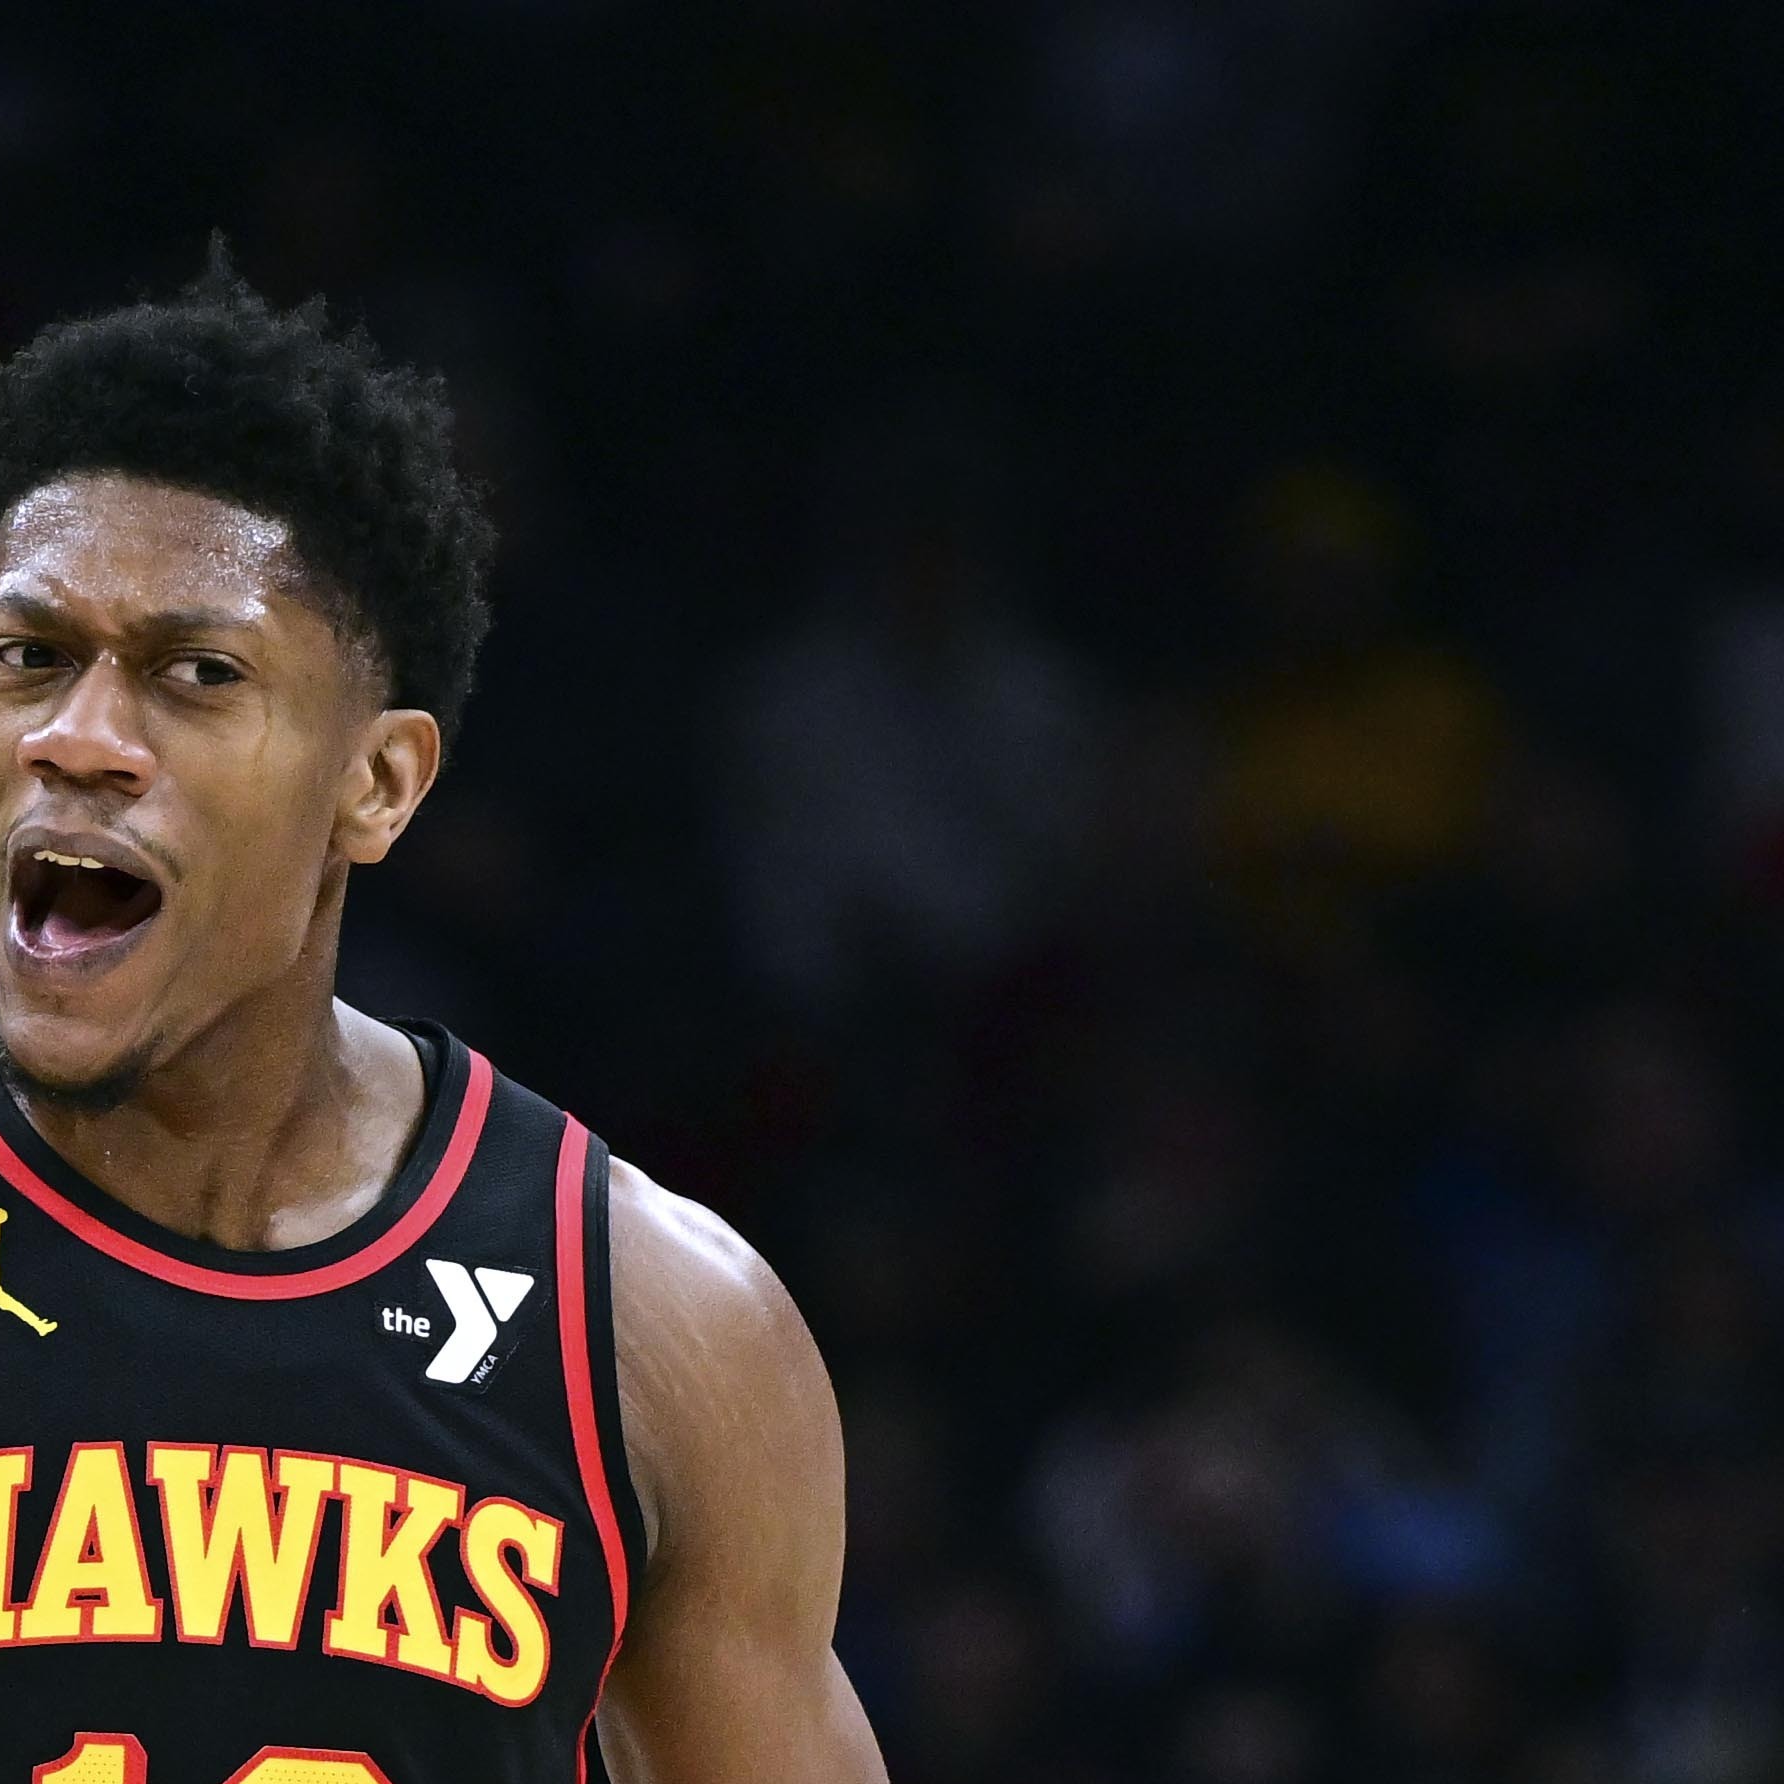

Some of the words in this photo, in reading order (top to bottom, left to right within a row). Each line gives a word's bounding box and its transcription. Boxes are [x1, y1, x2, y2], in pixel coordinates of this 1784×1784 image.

[381, 1306, 431, 1338] the
[425, 1258, 535, 1384] Y
[470, 1353, 500, 1386] YMCA
